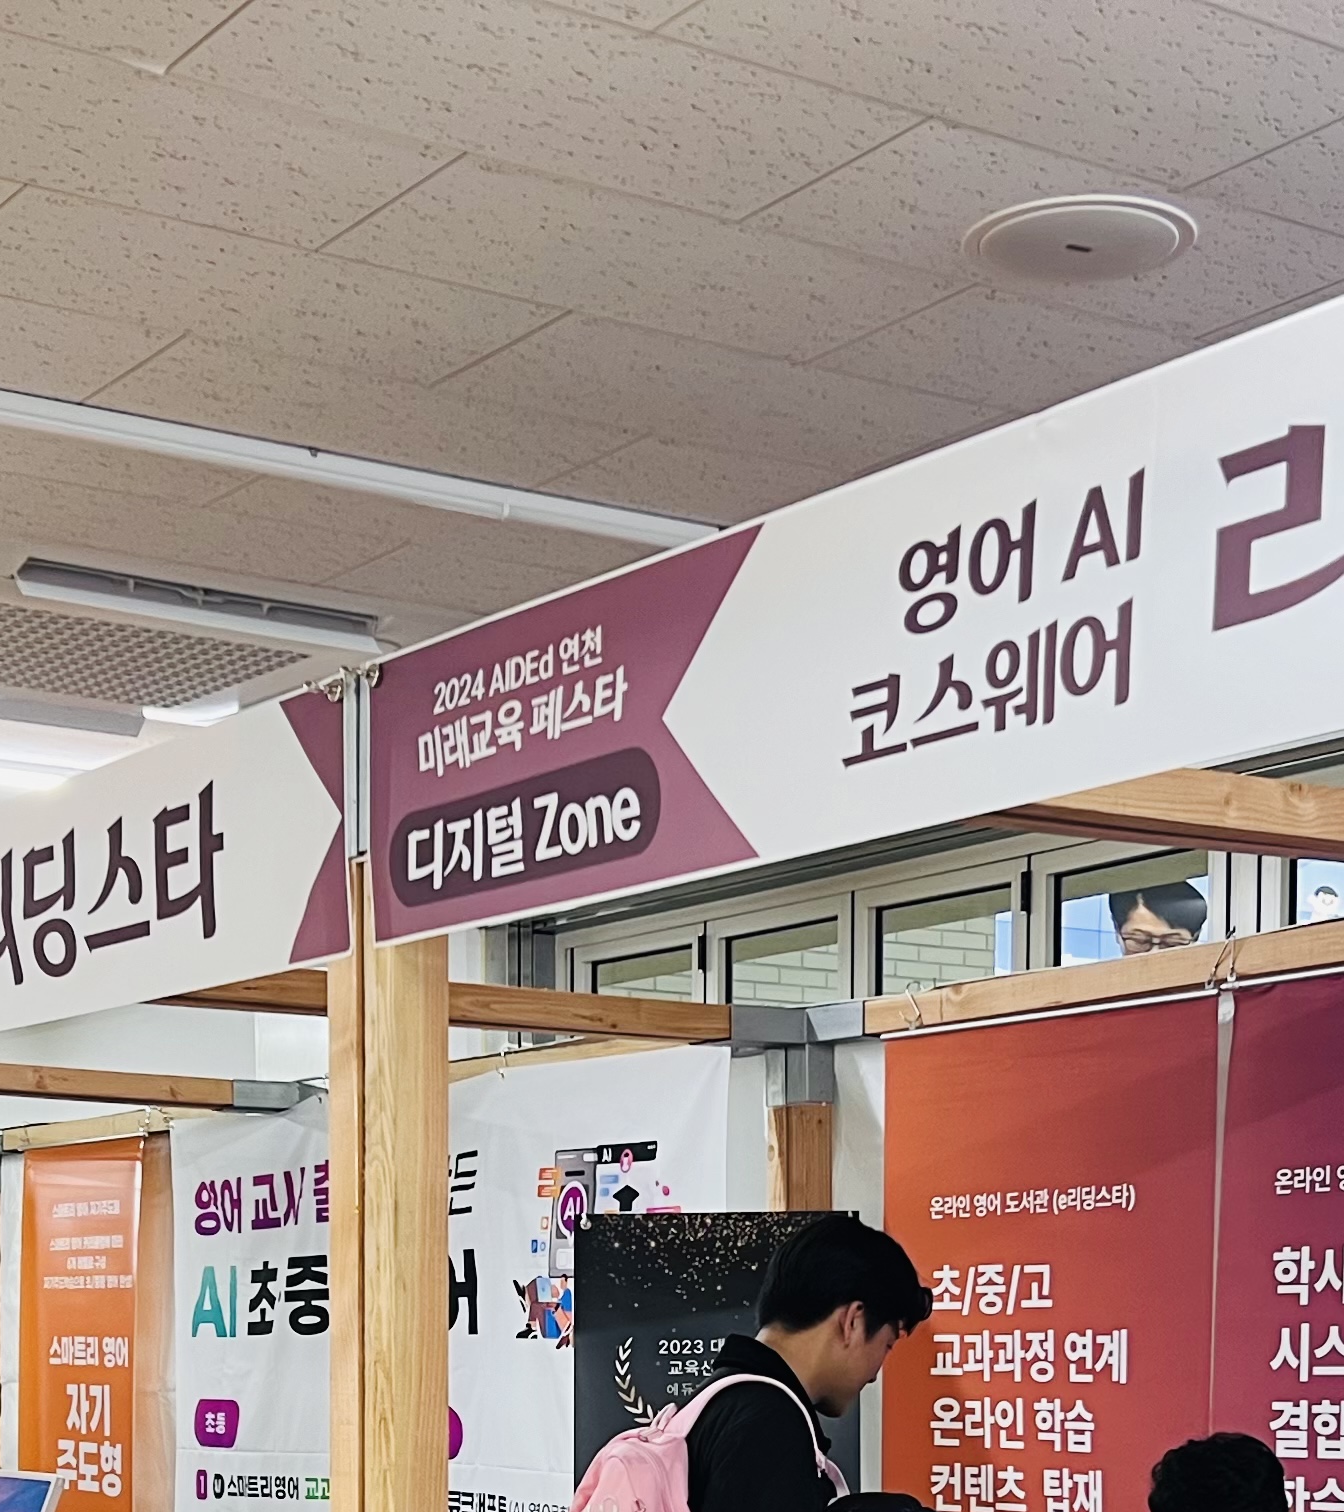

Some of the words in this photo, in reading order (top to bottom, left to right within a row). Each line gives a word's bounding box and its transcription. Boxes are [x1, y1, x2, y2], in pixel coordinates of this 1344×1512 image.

[899, 499, 1036, 634] 영어
[1061, 468, 1142, 582] AI
[433, 669, 484, 715] 2024
[489, 653, 553, 699] AIDEd
[557, 625, 603, 672] 연천
[842, 597, 1134, 768] 코스웨어
[417, 708, 524, 778] 미래교육
[529, 665, 626, 740] 페스타
[406, 799, 524, 890] 디지털
[535, 786, 641, 861] Zone
[194, 1177, 242, 1236] 영어
[251, 1166, 305, 1234] 교사
[930, 1194, 970, 1220] 온라인
[973, 1191, 1001, 1217] 영어
[1005, 1187, 1049, 1215] 도서관
[1053, 1183, 1135, 1214] (e리딩스타)
[1274, 1164, 1331, 1195] 온라인
[192, 1265, 237, 1338] AI
[933, 1264, 1053, 1316] 초/중/고
[49, 1335, 99, 1368] 스마트리
[102, 1336, 129, 1368] 영어
[659, 1340, 704, 1354] 2023
[930, 1330, 1056, 1384] 교과과정
[1064, 1329, 1128, 1385] 연계
[65, 1384, 111, 1437] 자기
[666, 1383, 702, 1397] 에듀
[205, 1411, 227, 1434] 초등
[930, 1398, 1025, 1450] 온라인
[1034, 1398, 1094, 1454] 학습
[57, 1441, 123, 1498] 주도형
